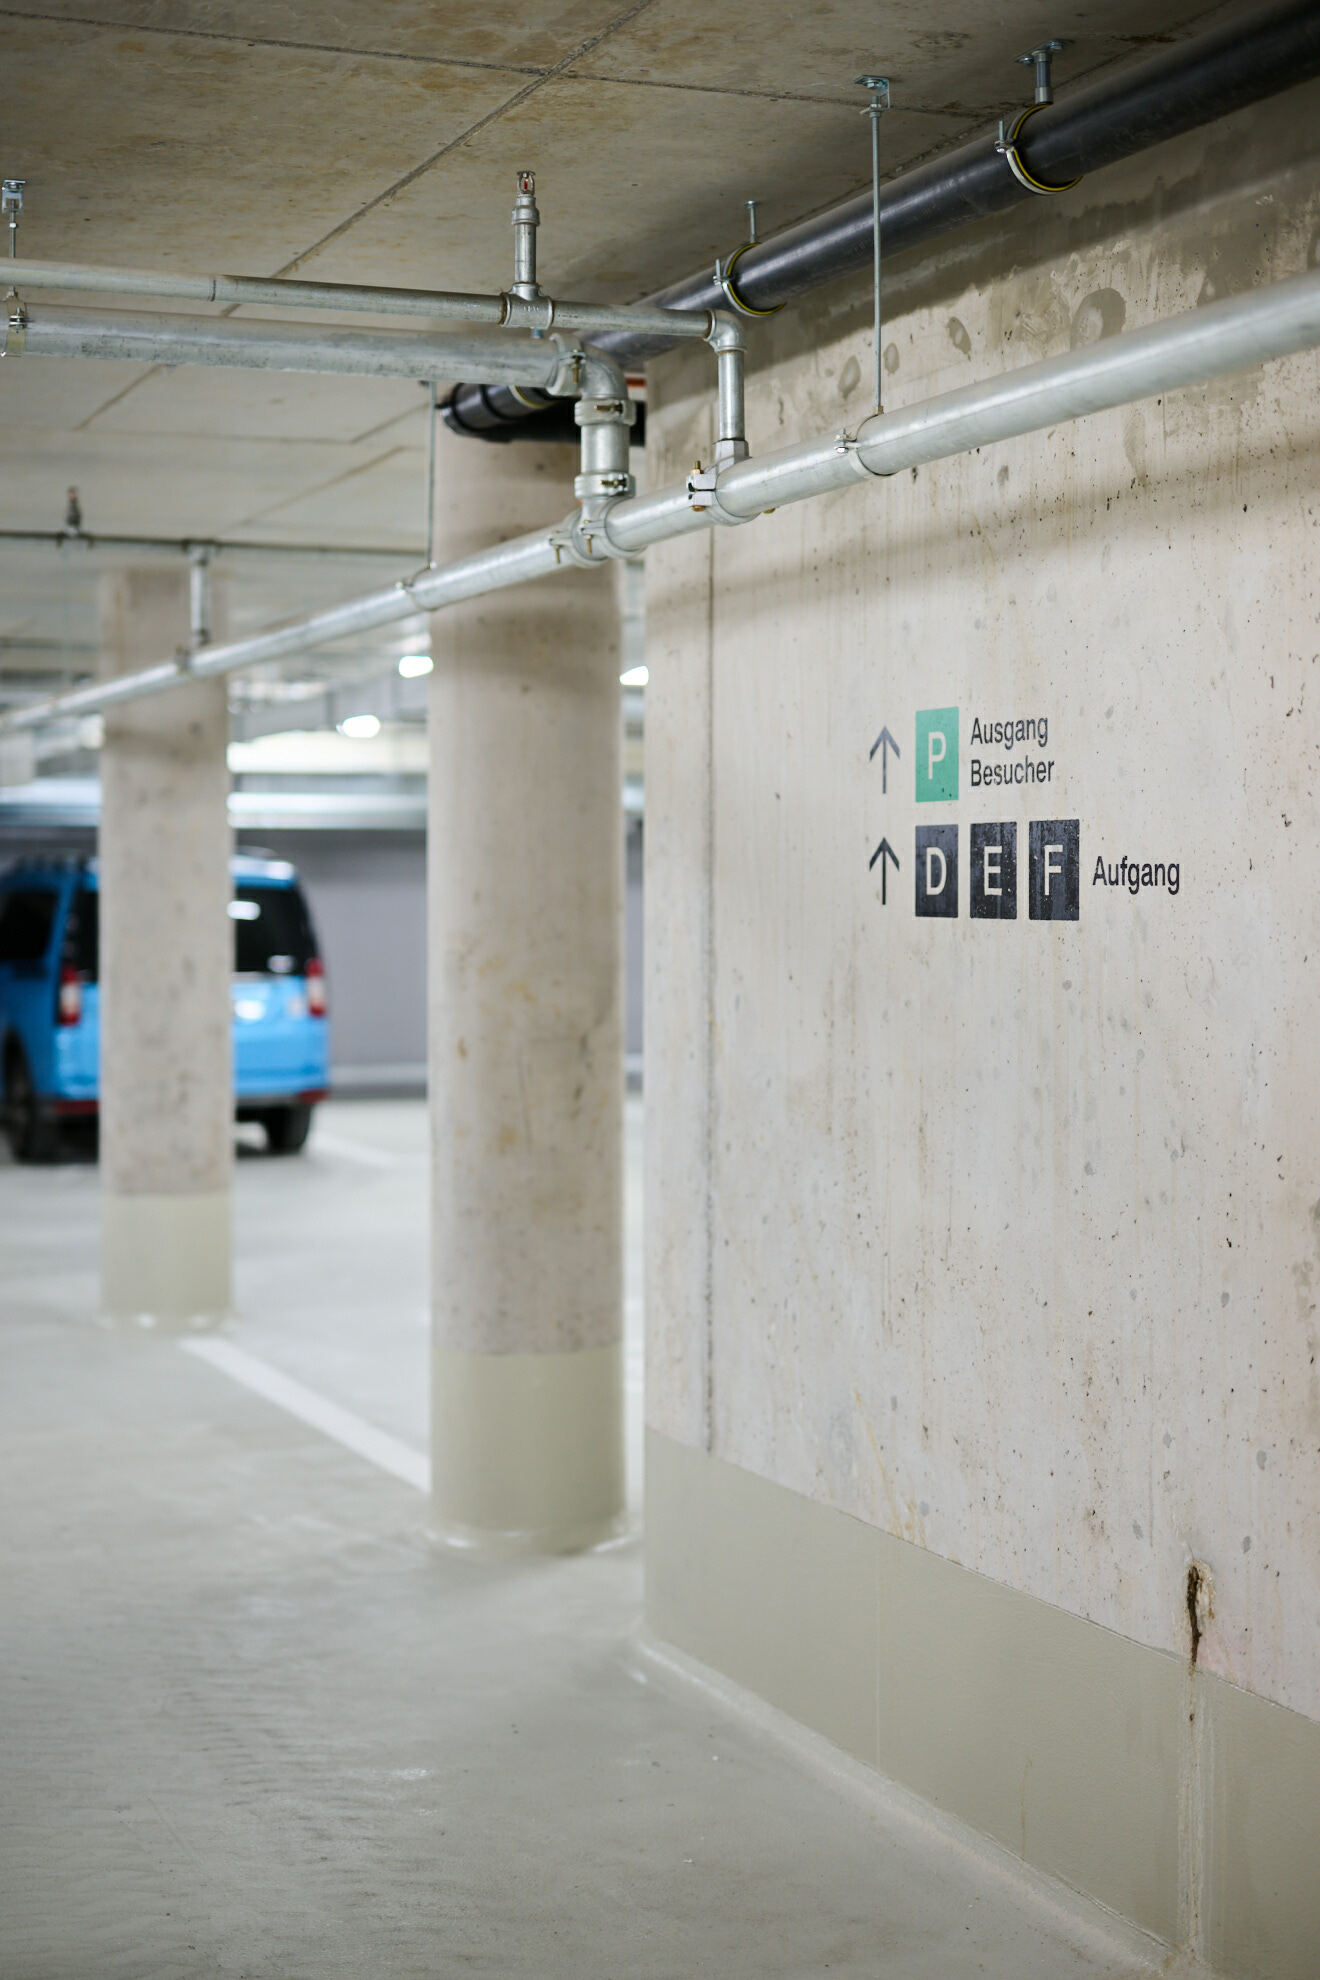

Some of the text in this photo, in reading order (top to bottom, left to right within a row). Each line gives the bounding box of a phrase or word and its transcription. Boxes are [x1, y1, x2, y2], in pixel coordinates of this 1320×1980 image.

[970, 716, 1049, 750] Ausgang
[928, 731, 947, 780] P
[971, 755, 1055, 787] Besucher
[926, 844, 1180, 896] D E F Aufgang
